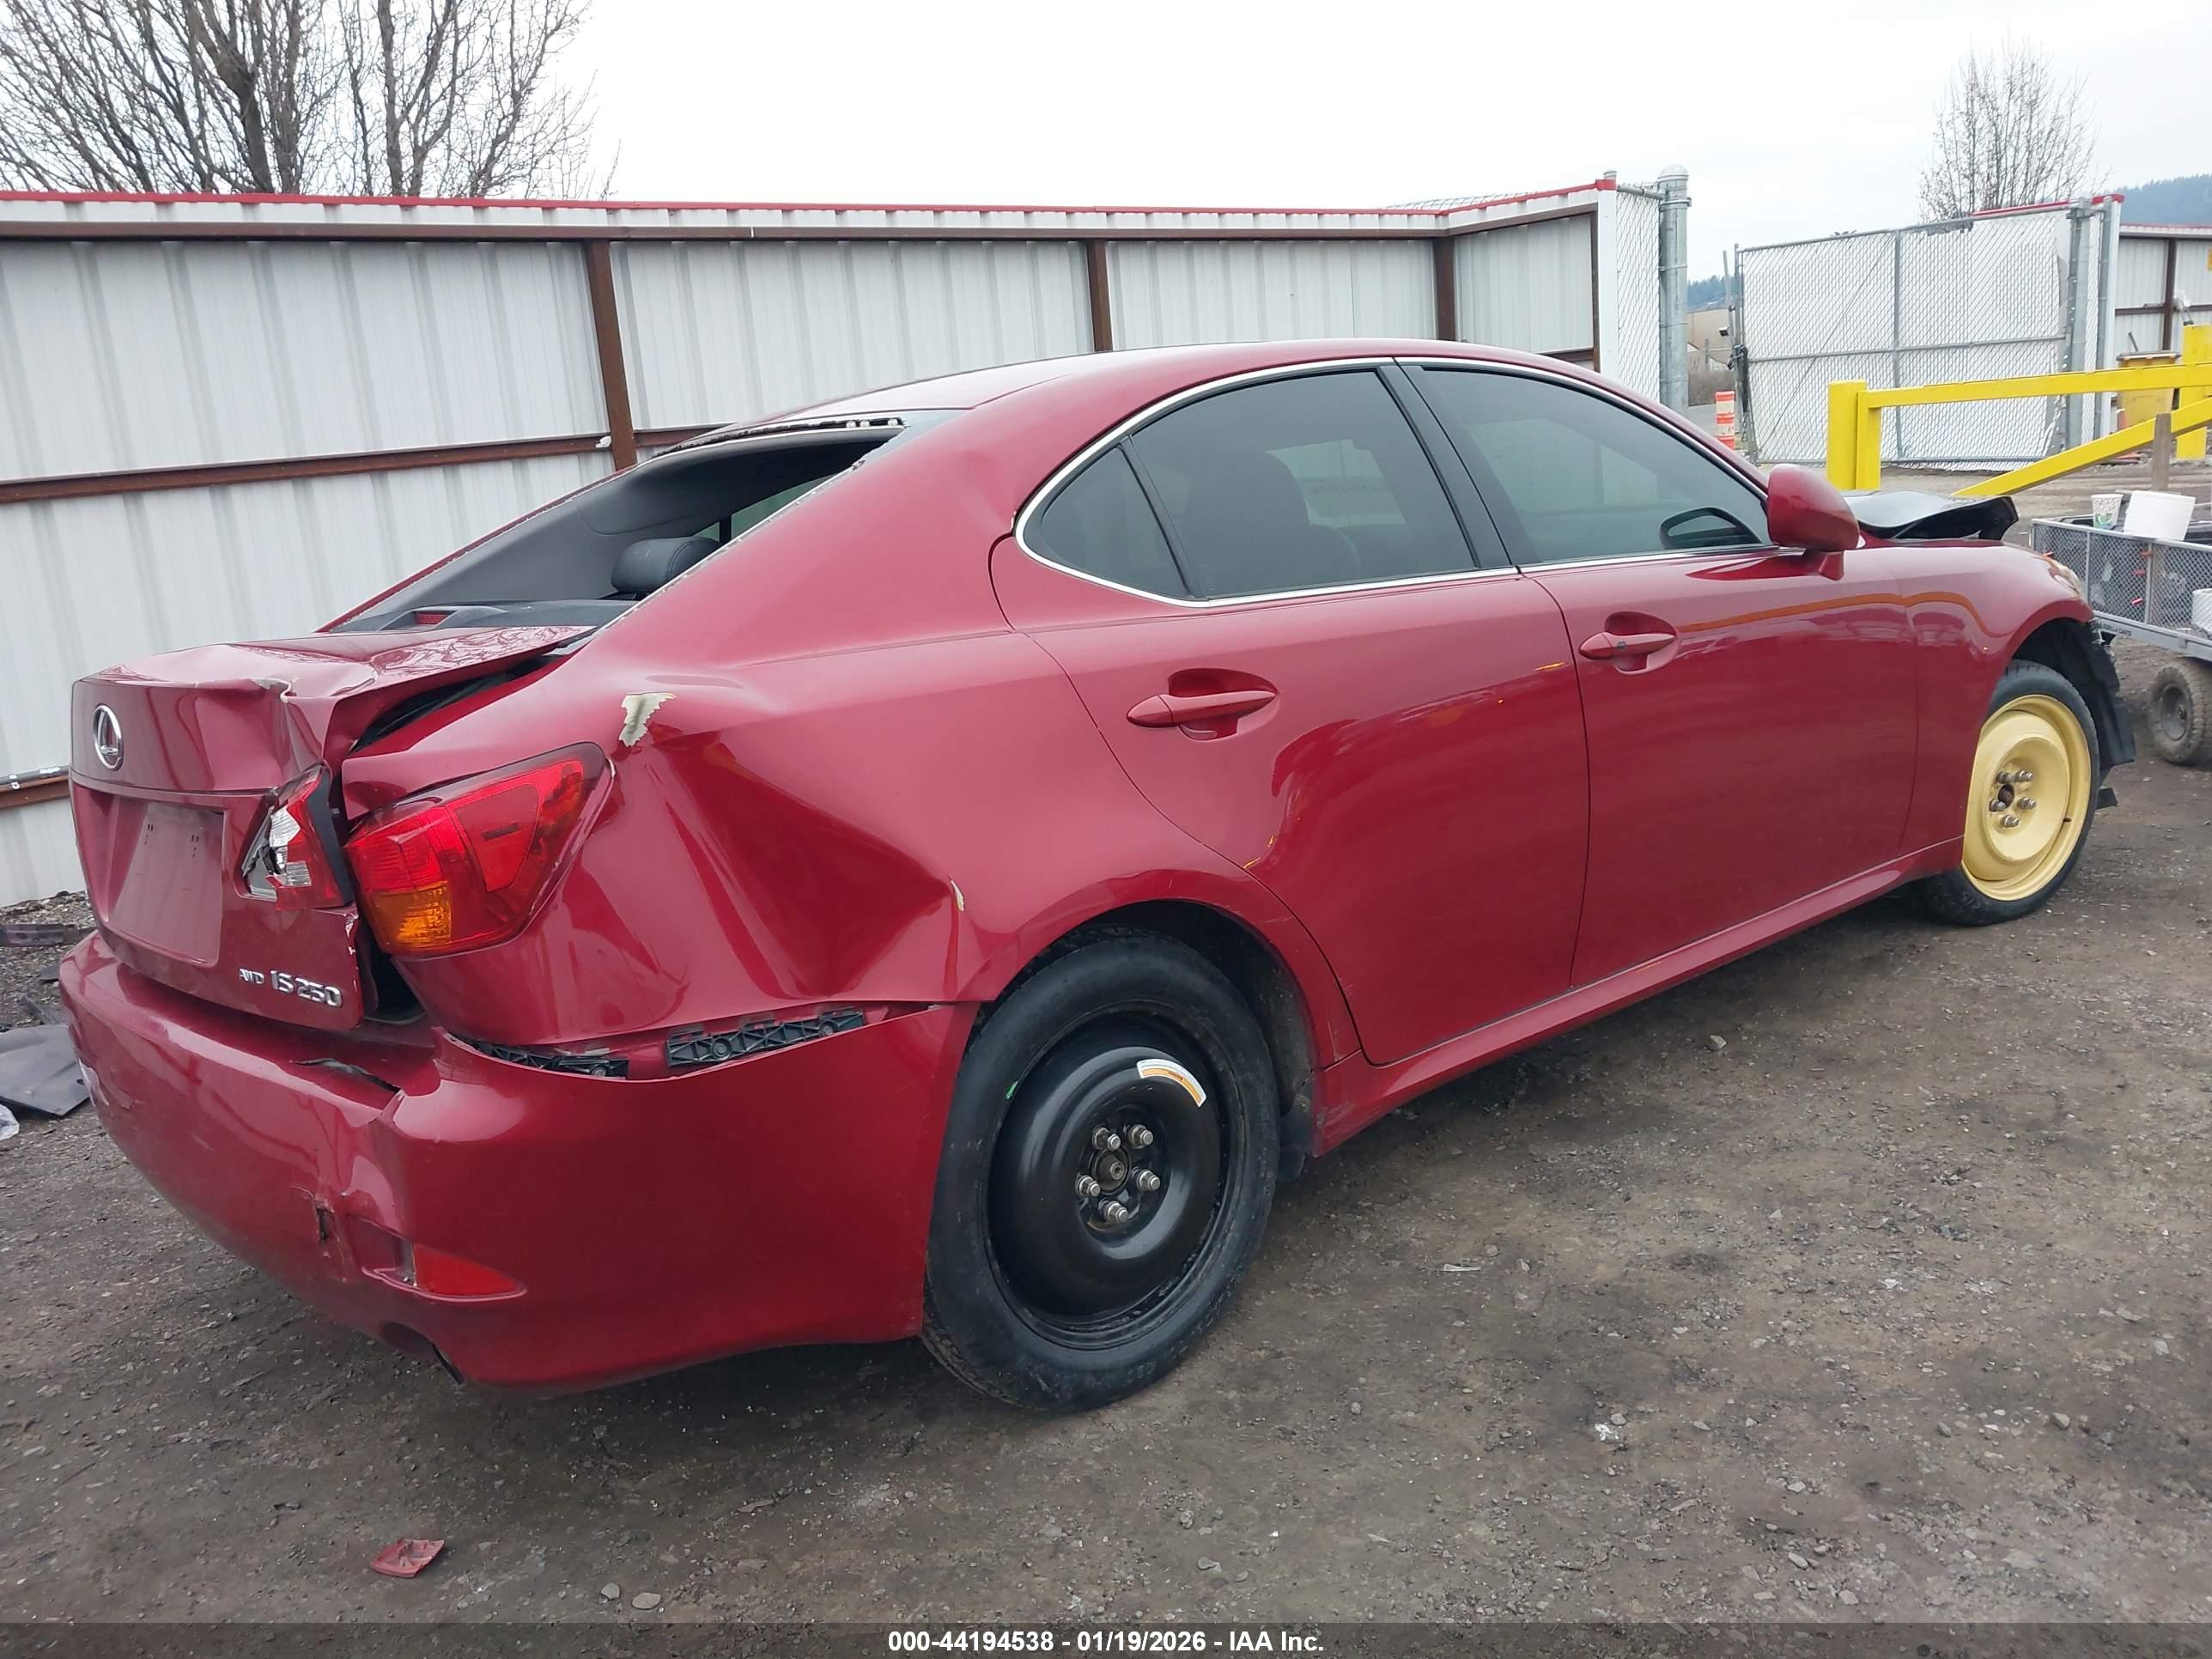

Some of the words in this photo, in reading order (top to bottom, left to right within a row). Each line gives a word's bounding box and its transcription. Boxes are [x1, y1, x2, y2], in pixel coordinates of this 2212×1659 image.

[239, 968, 264, 984] AWD
[270, 969, 294, 994] IS
[295, 977, 343, 1007] 250
